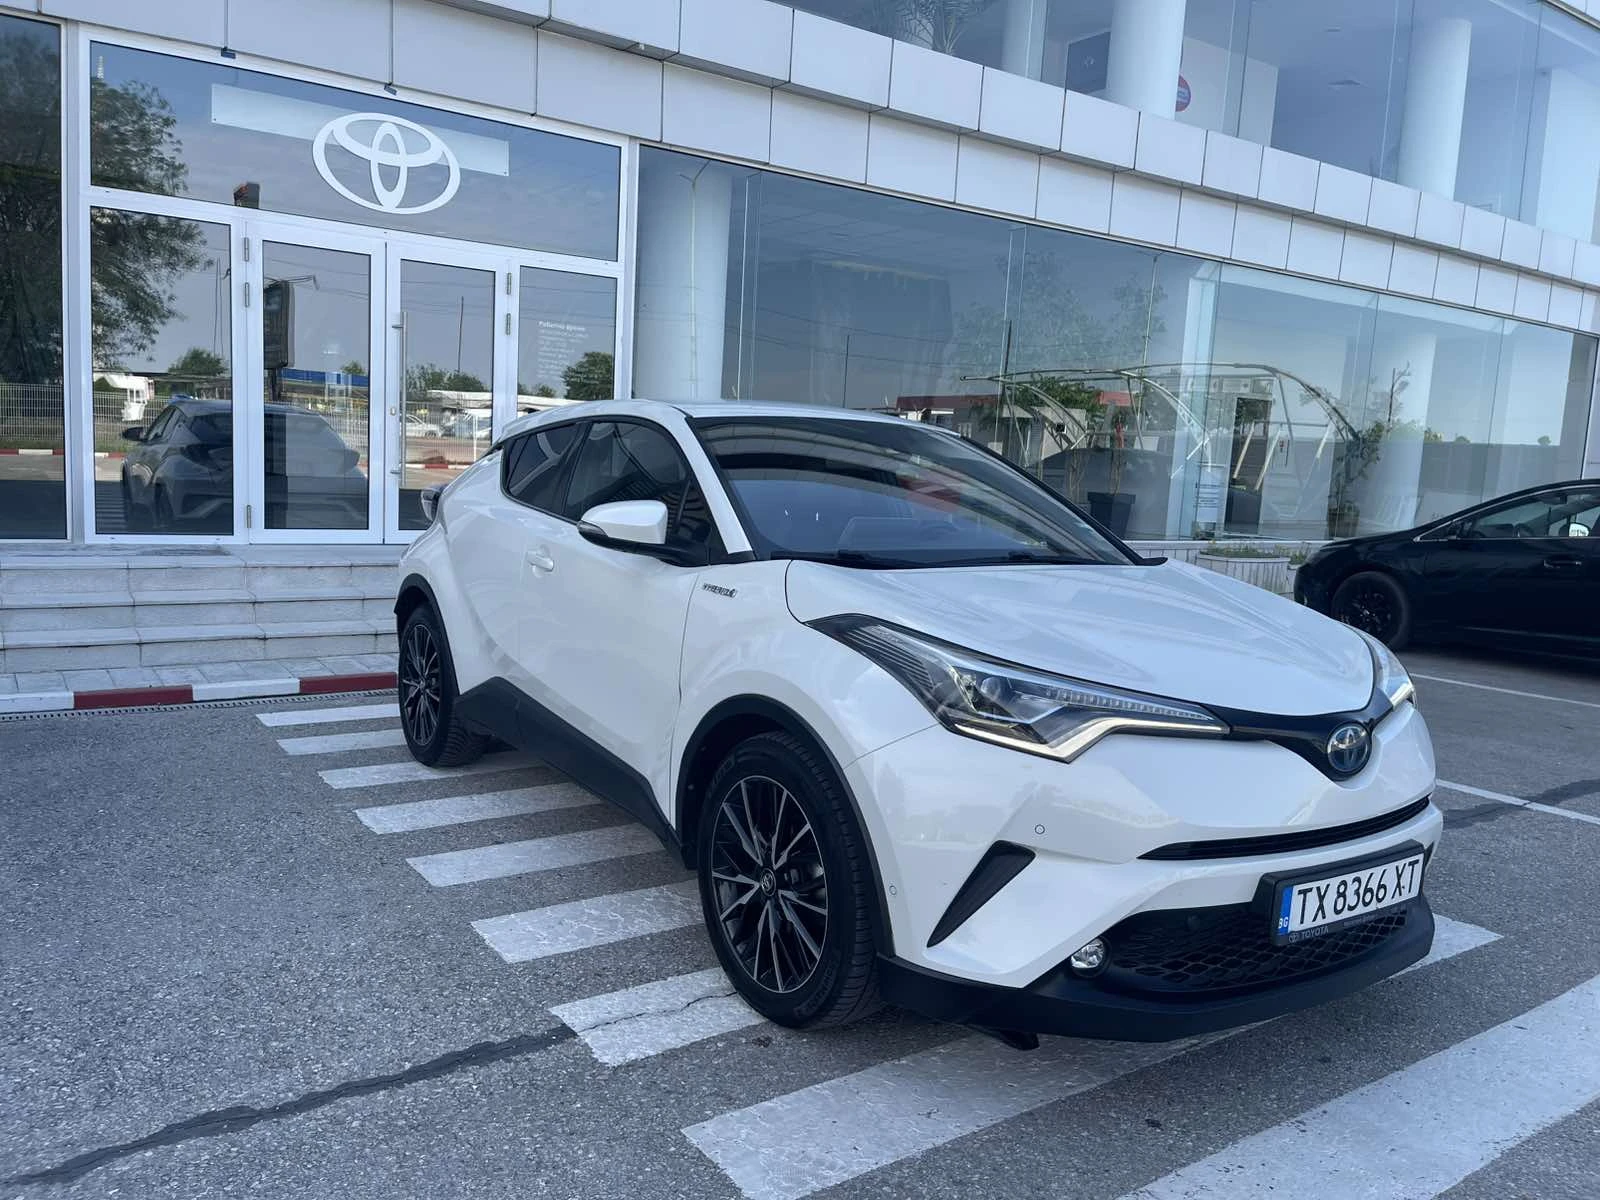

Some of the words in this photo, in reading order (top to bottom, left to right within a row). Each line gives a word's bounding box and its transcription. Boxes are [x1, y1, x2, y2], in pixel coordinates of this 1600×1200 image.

[1297, 883, 1330, 925] TX
[1333, 868, 1387, 916] 8366
[1391, 858, 1420, 899] XT
[1301, 925, 1329, 940] TOYOTA
